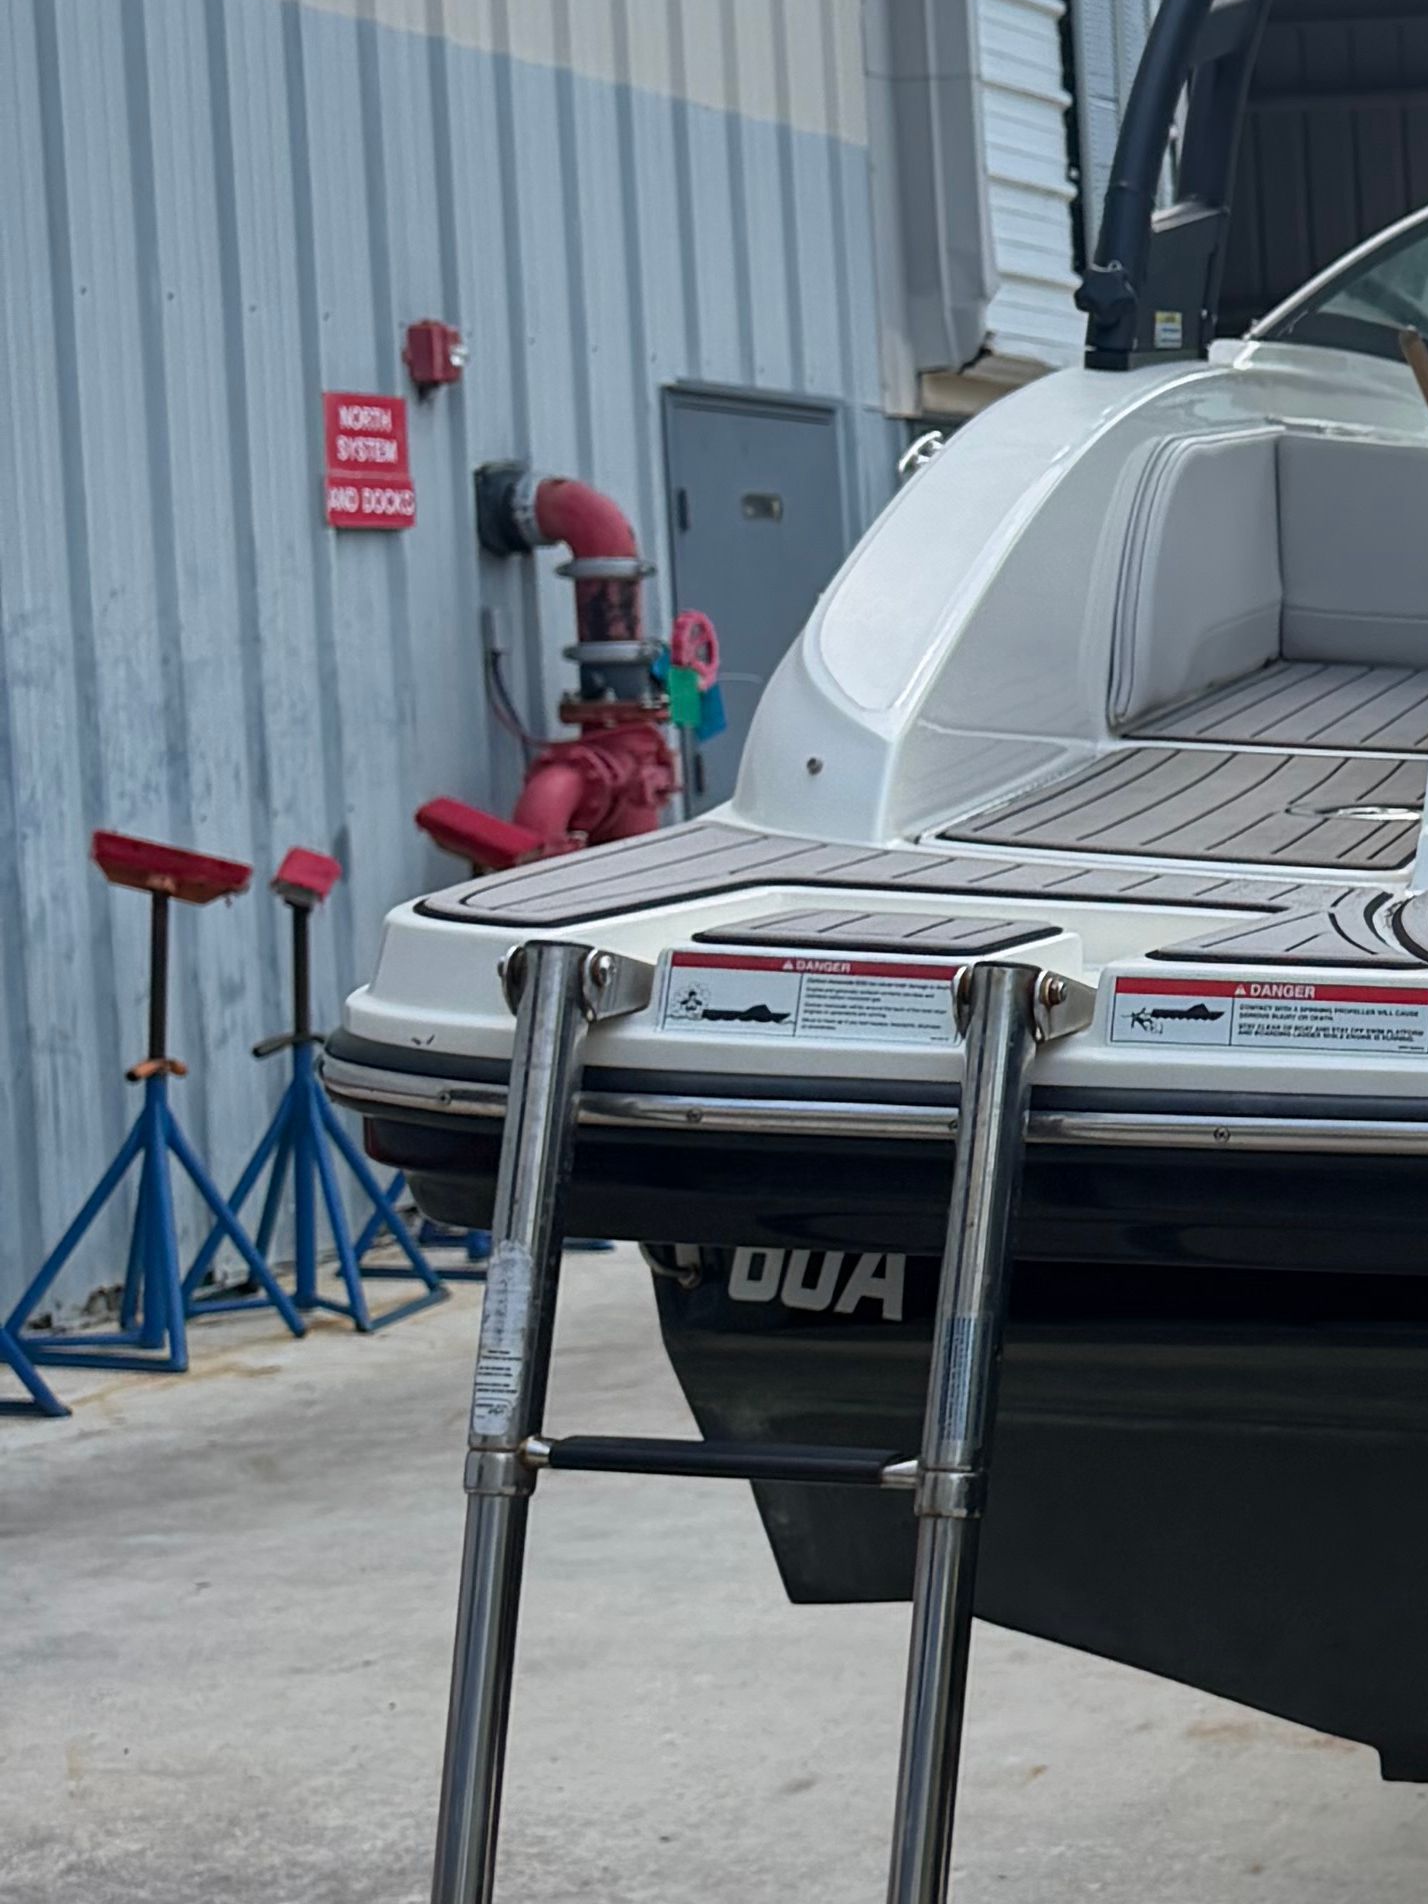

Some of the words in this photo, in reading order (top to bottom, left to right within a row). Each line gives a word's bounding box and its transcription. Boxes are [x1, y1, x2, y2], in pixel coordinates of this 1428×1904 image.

[339, 404, 393, 432] NORTH
[336, 434, 399, 464] SYSTEM
[796, 960, 852, 974] DANGER
[1249, 983, 1316, 999] DANGER
